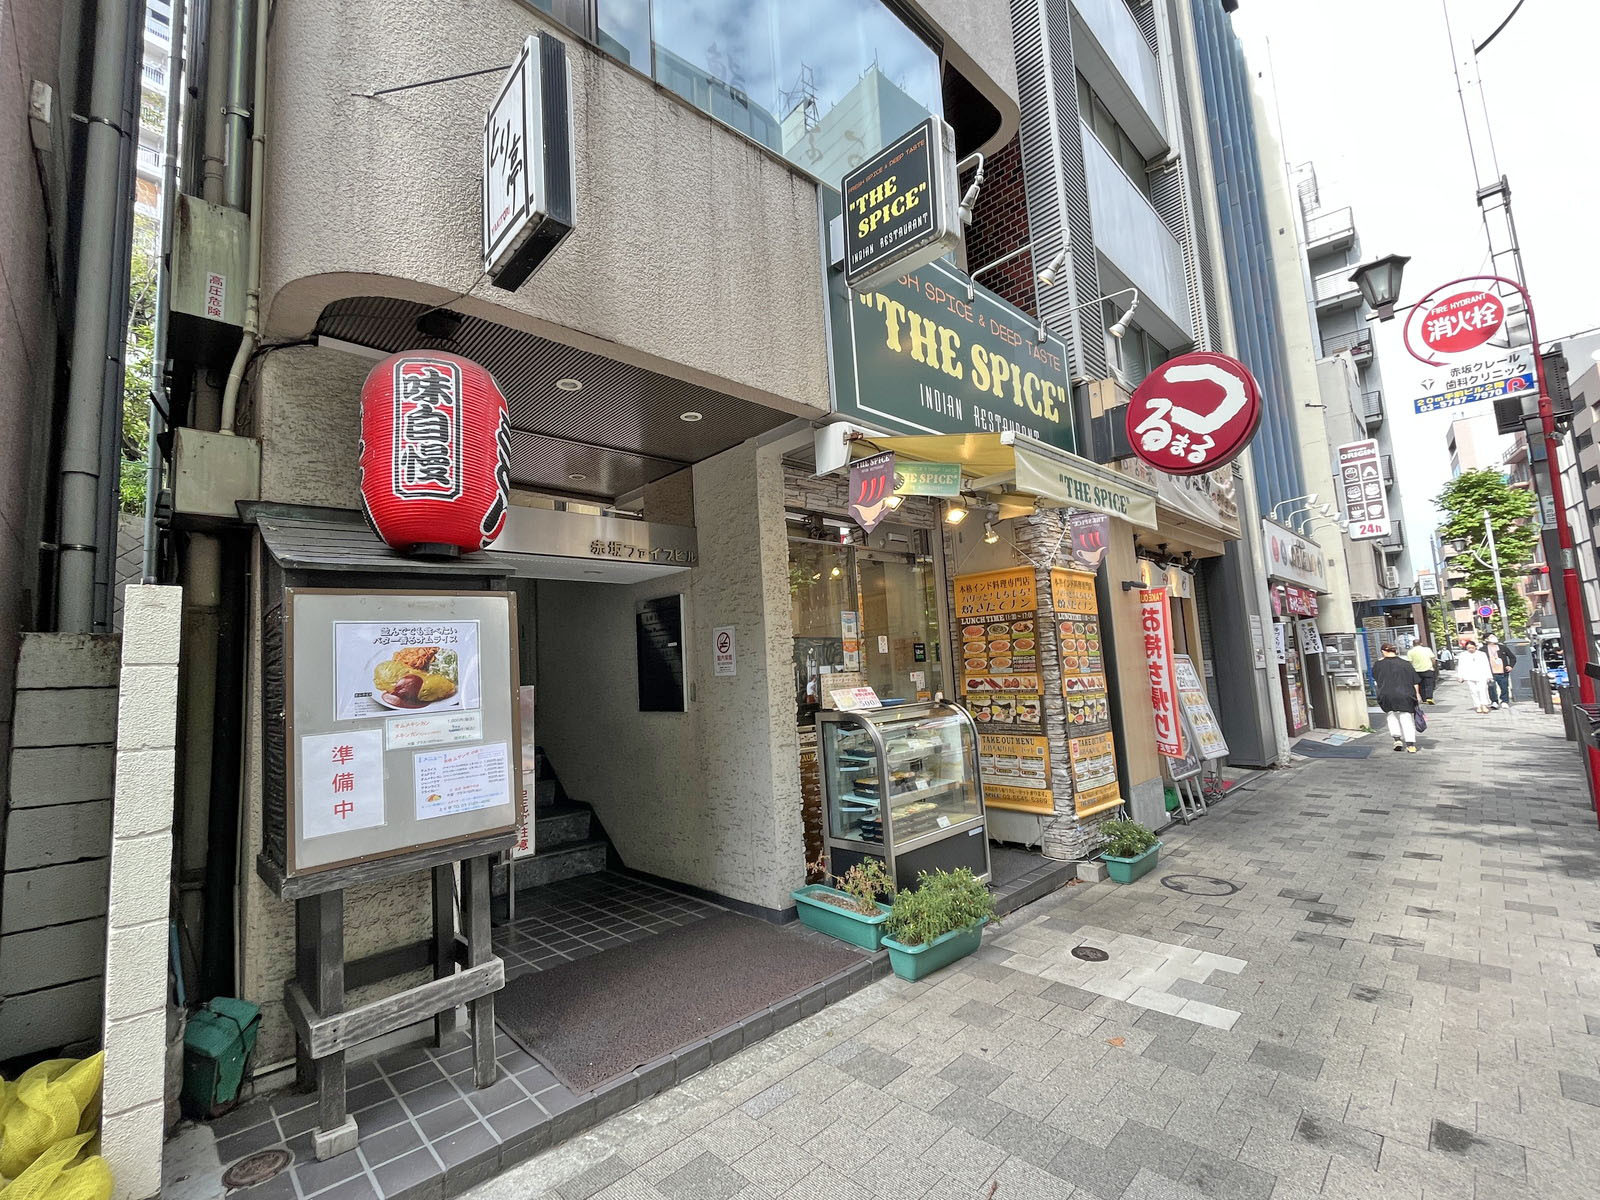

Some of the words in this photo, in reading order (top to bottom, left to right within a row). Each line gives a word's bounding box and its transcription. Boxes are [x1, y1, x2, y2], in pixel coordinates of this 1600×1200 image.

[906, 138, 926, 155] TASTE
[851, 243, 874, 265] INDIAN
[879, 212, 929, 249] RESTAURANT
[208, 273, 224, 319] 高圧危険
[1430, 302, 1449, 317] FIRE
[1450, 292, 1487, 311] HYDRANT
[924, 281, 974, 323] SPICE
[978, 314, 986, 328] &
[989, 319, 1022, 347] DEEP
[1025, 340, 1062, 372] TASTE
[1425, 301, 1499, 344] 消火栓
[859, 291, 964, 381] "THE
[971, 343, 1066, 424] SPICE"
[1446, 363, 1527, 391] 歯科クリニック
[1450, 353, 1521, 378] 赤坂クレール
[919, 382, 964, 421] INDIAN
[401, 366, 455, 489] 味自慢
[1340, 447, 1377, 460] ORIGIN
[961, 616, 986, 625] LUNCH
[987, 613, 1005, 624] TIME
[981, 735, 1001, 744] TAKE
[1001, 736, 1015, 745] OUT
[1015, 737, 1035, 746] MENU
[331, 744, 355, 820] 準備中
